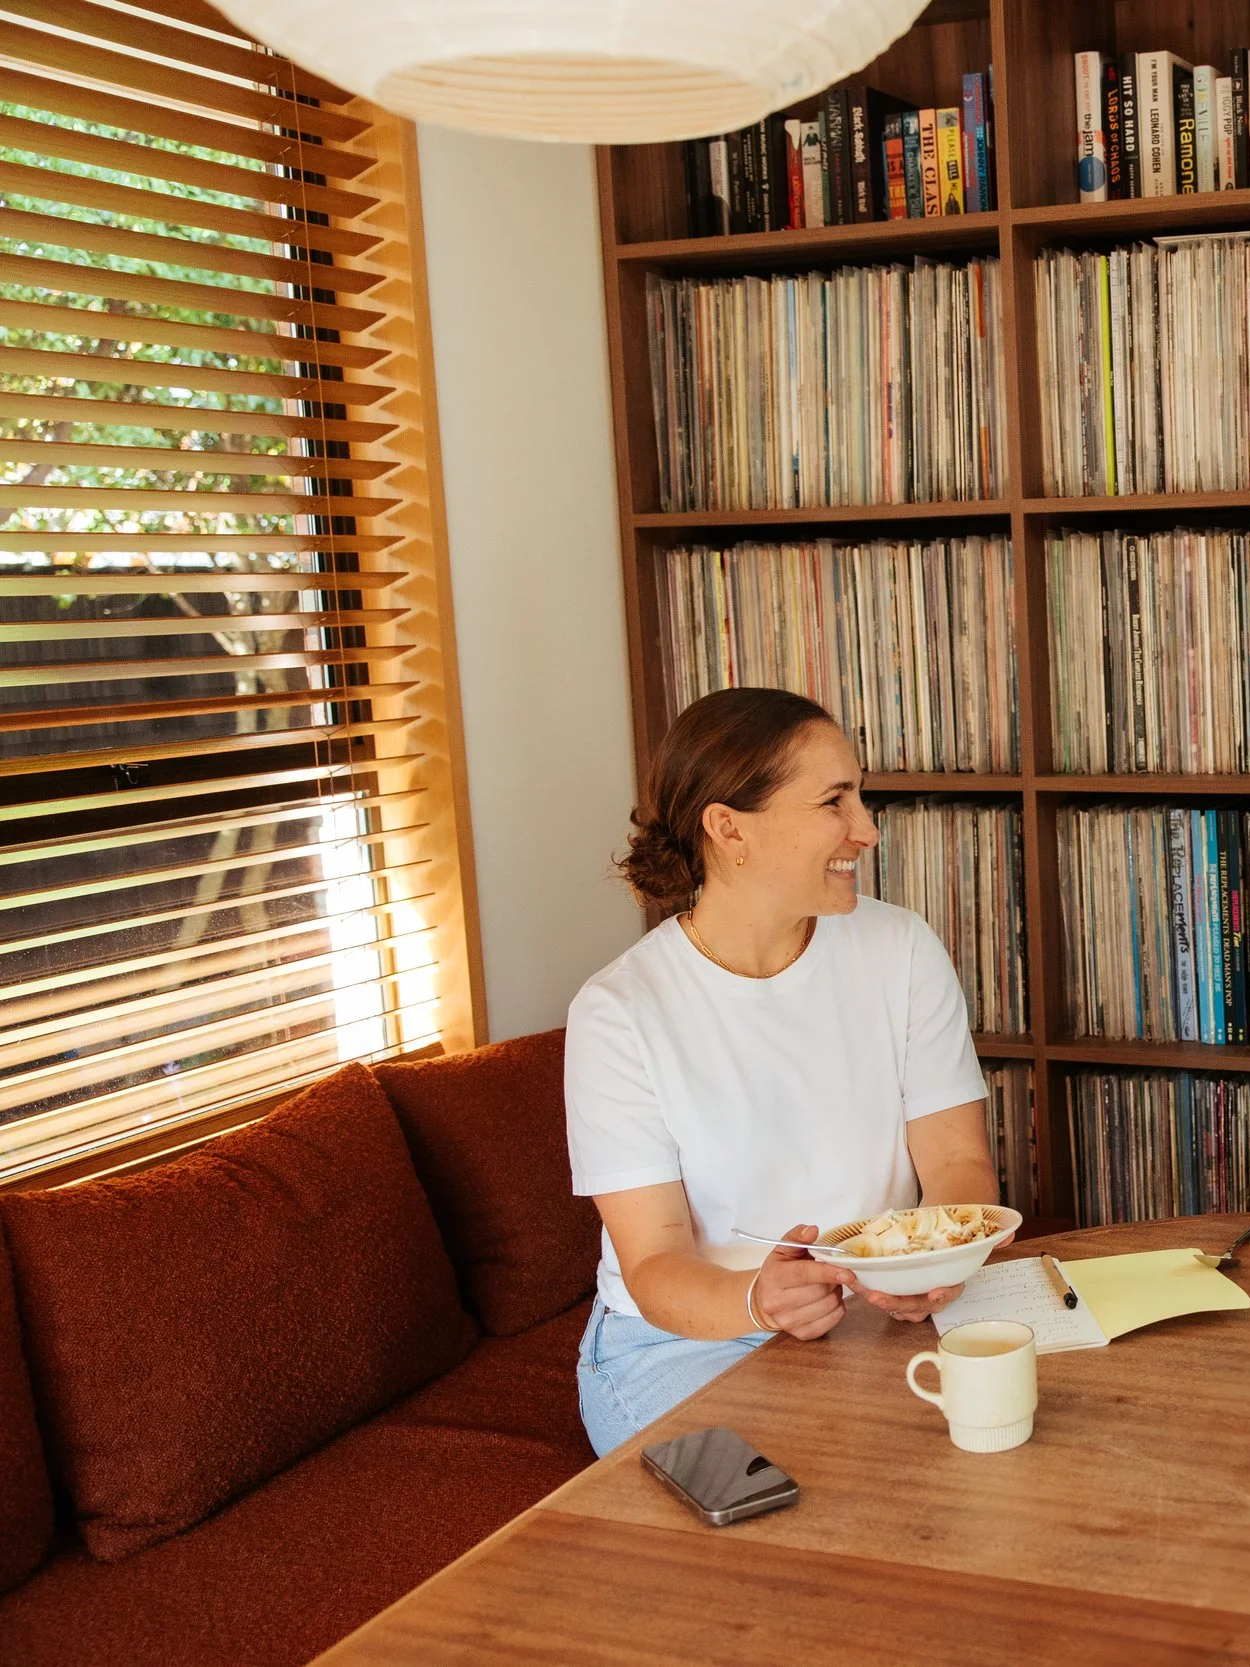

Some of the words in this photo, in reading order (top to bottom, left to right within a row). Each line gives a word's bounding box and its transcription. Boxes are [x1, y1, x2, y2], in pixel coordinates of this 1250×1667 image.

[1122, 77, 1133, 96] HIT
[1151, 71, 1159, 87] YOUR
[1107, 88, 1120, 130] LORDS
[1123, 100, 1133, 116] SO
[1222, 96, 1232, 117] IGGY
[1235, 95, 1243, 115] Black
[828, 93, 842, 151] STARMAN
[852, 106, 864, 131] Black
[1084, 113, 1094, 129] the
[1150, 108, 1161, 145] LEONARD
[1223, 118, 1233, 135] POP
[854, 131, 867, 163] Sabbath
[921, 124, 936, 160] THE
[946, 128, 958, 158] PLEASE
[1083, 130, 1096, 157] jam
[1110, 133, 1119, 143] OF
[1124, 120, 1135, 152] HARD
[1110, 145, 1121, 183] CHAOS
[1151, 147, 1162, 174] COHEN
[1179, 118, 1195, 194] Ramone
[923, 168, 939, 216] CLAS
[951, 182, 959, 193] ME
[1219, 851, 1228, 868] THE
[1210, 874, 1219, 922] REPLACEMENTS
[1220, 870, 1230, 934] REPLACEMENTS
[1223, 938, 1231, 961] DEAD
[1224, 963, 1232, 988] MAN'S
[1225, 990, 1233, 1006] POP
